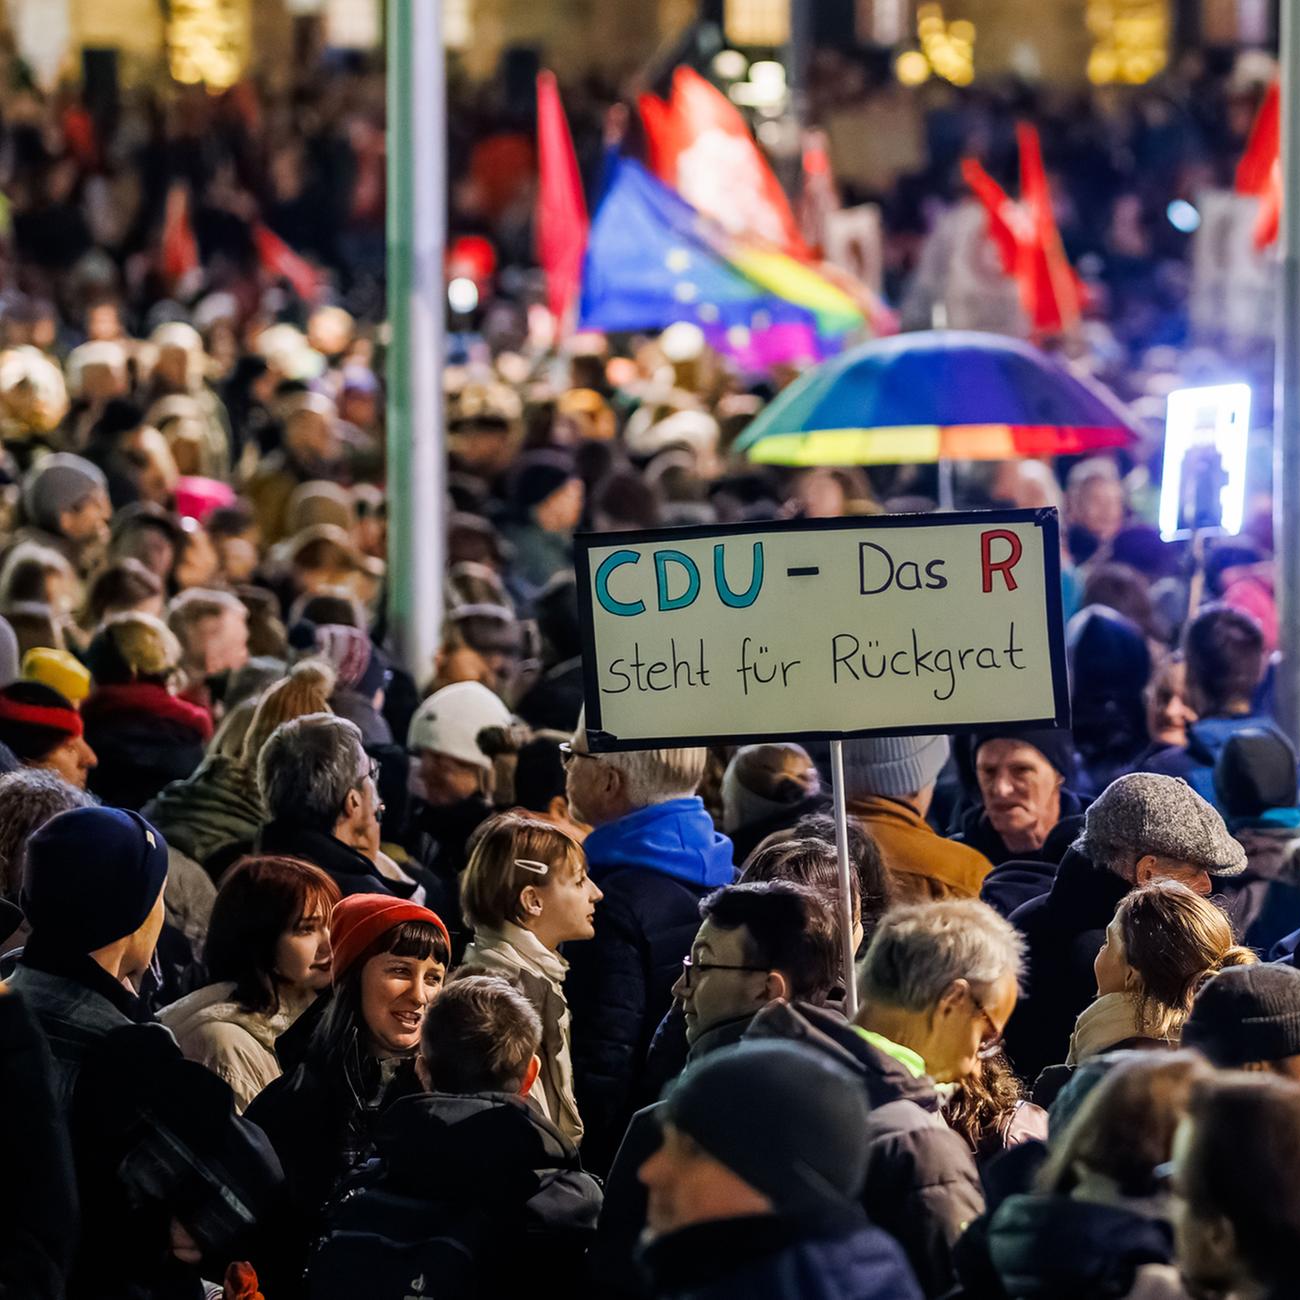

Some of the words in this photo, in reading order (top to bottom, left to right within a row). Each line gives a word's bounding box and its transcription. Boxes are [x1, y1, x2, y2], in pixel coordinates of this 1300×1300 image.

[594, 541, 765, 617] CDU
[786, 565, 820, 578] -
[858, 541, 949, 596] Das
[980, 529, 1023, 594] R
[601, 637, 711, 694] steht
[736, 636, 801, 696] für
[831, 621, 1028, 701] Rückgrat
